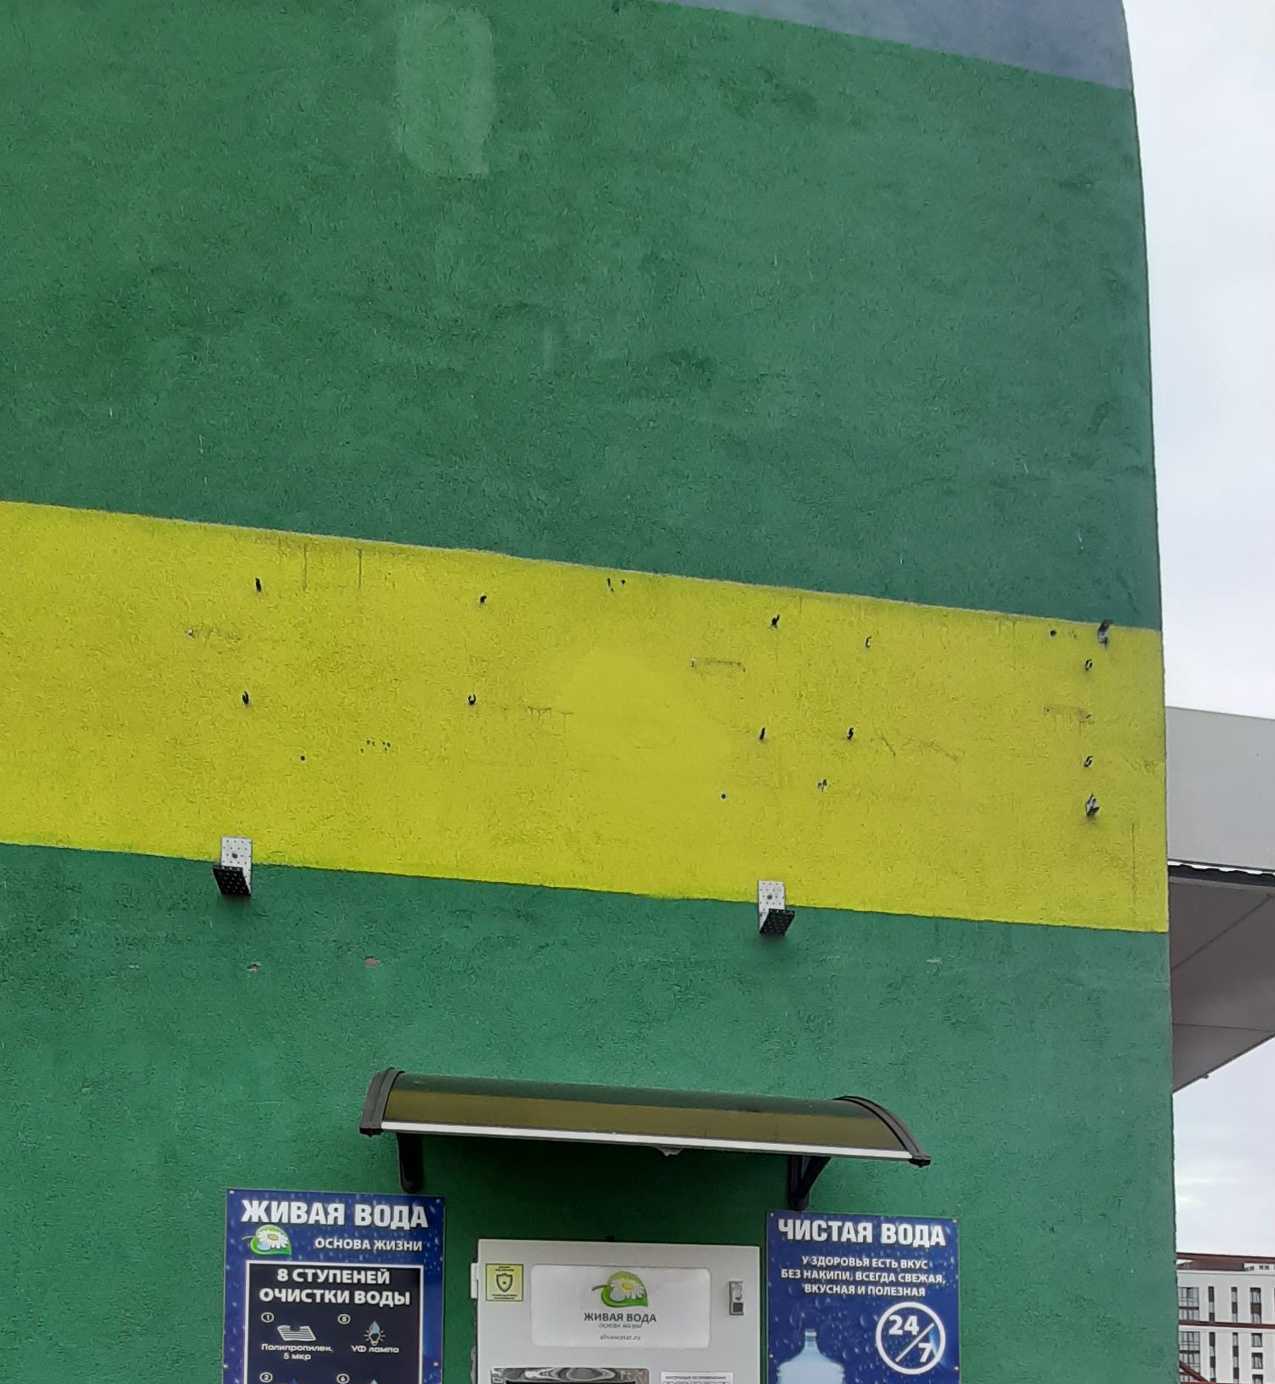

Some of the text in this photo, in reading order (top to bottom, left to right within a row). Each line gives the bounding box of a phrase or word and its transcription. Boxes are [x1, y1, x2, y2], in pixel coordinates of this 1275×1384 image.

[241, 1199, 429, 1230] ЖИВАЯ ВОДА
[778, 1218, 947, 1248] ЧИСТАЯ ВОДА
[315, 1237, 423, 1252] ОСНОВА ЖИЗНИ
[801, 1256, 928, 1269] У ЗДОРОВЬЯ ЕСТЬ ВКУС
[276, 1268, 391, 1285] 8 СТУПЕНЕЙ
[781, 1268, 946, 1284] БЕЗ НАКИПИ, ВСЕГДА СВЕЖАЯ,
[259, 1288, 411, 1308] ОЧИСТКИ ВОДЫ
[804, 1284, 926, 1297] ВКУСНАЯ И ПОЛЕЗНАЯ
[584, 1312, 657, 1325] ЖИВАЯ ВОДА
[291, 1353, 312, 1361] мкр
[351, 1345, 400, 1354] УФ лампа
